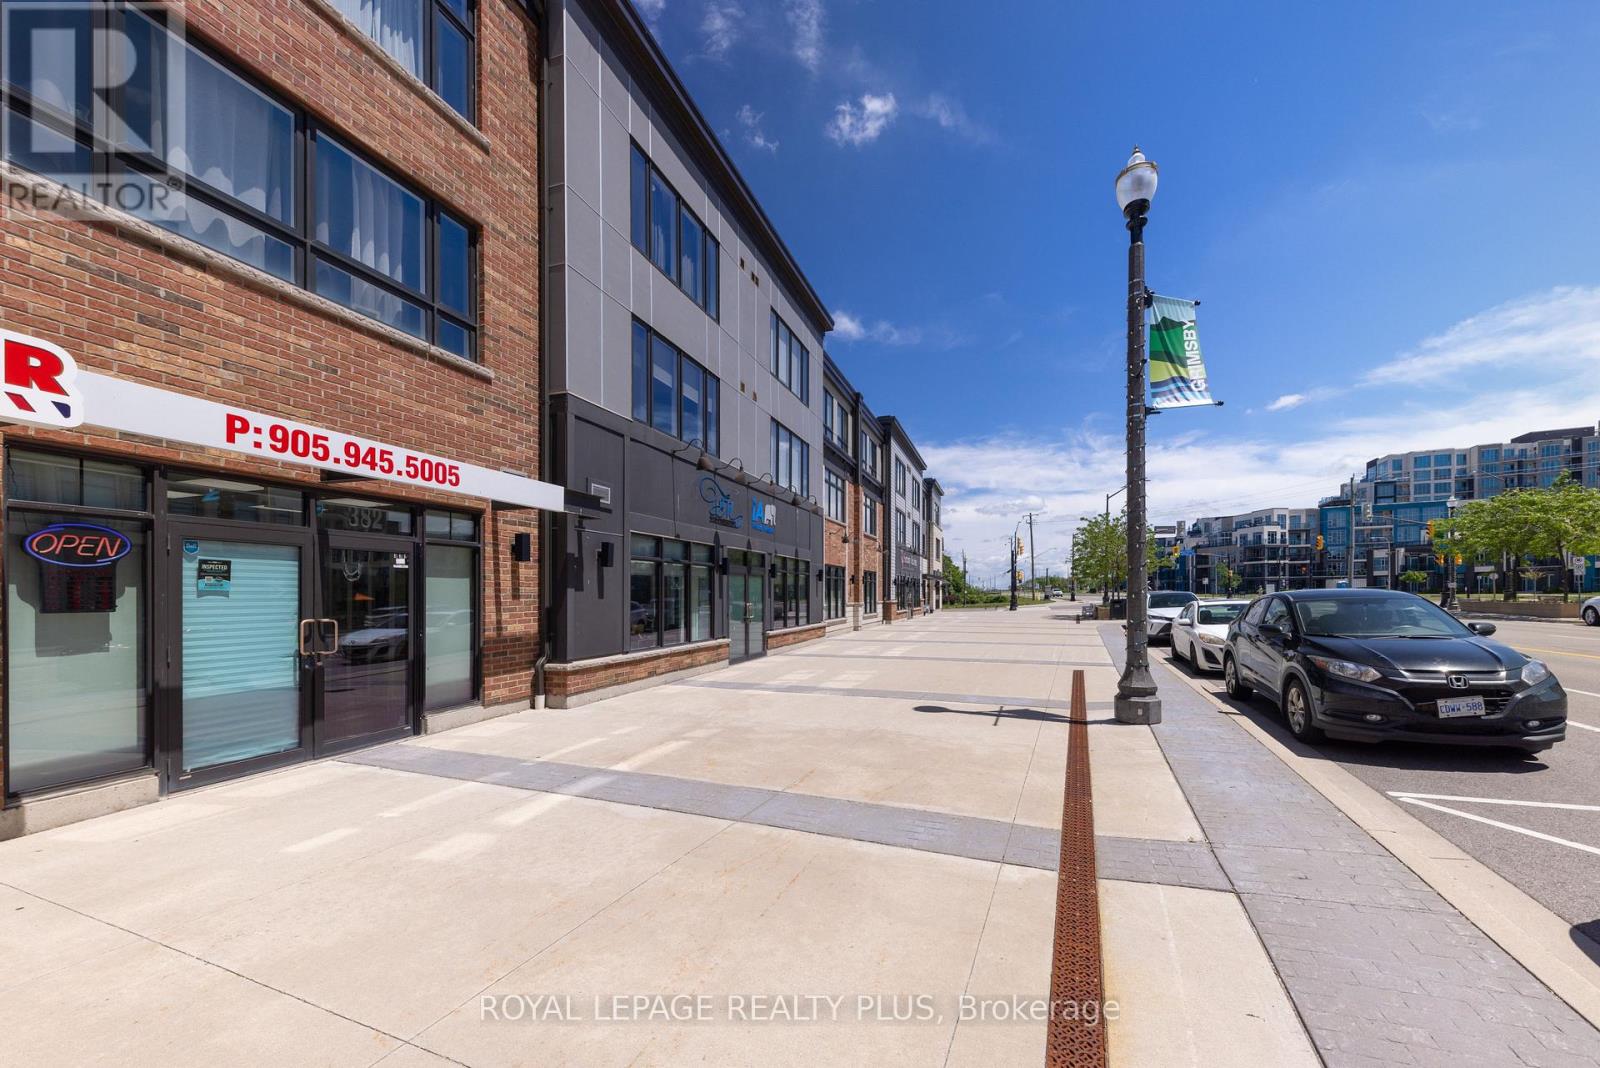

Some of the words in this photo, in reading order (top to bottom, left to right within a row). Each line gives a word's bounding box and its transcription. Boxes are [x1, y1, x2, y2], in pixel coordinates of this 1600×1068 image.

[4, 339, 70, 397] R
[348, 507, 383, 528] 382
[32, 533, 121, 557] OPEN
